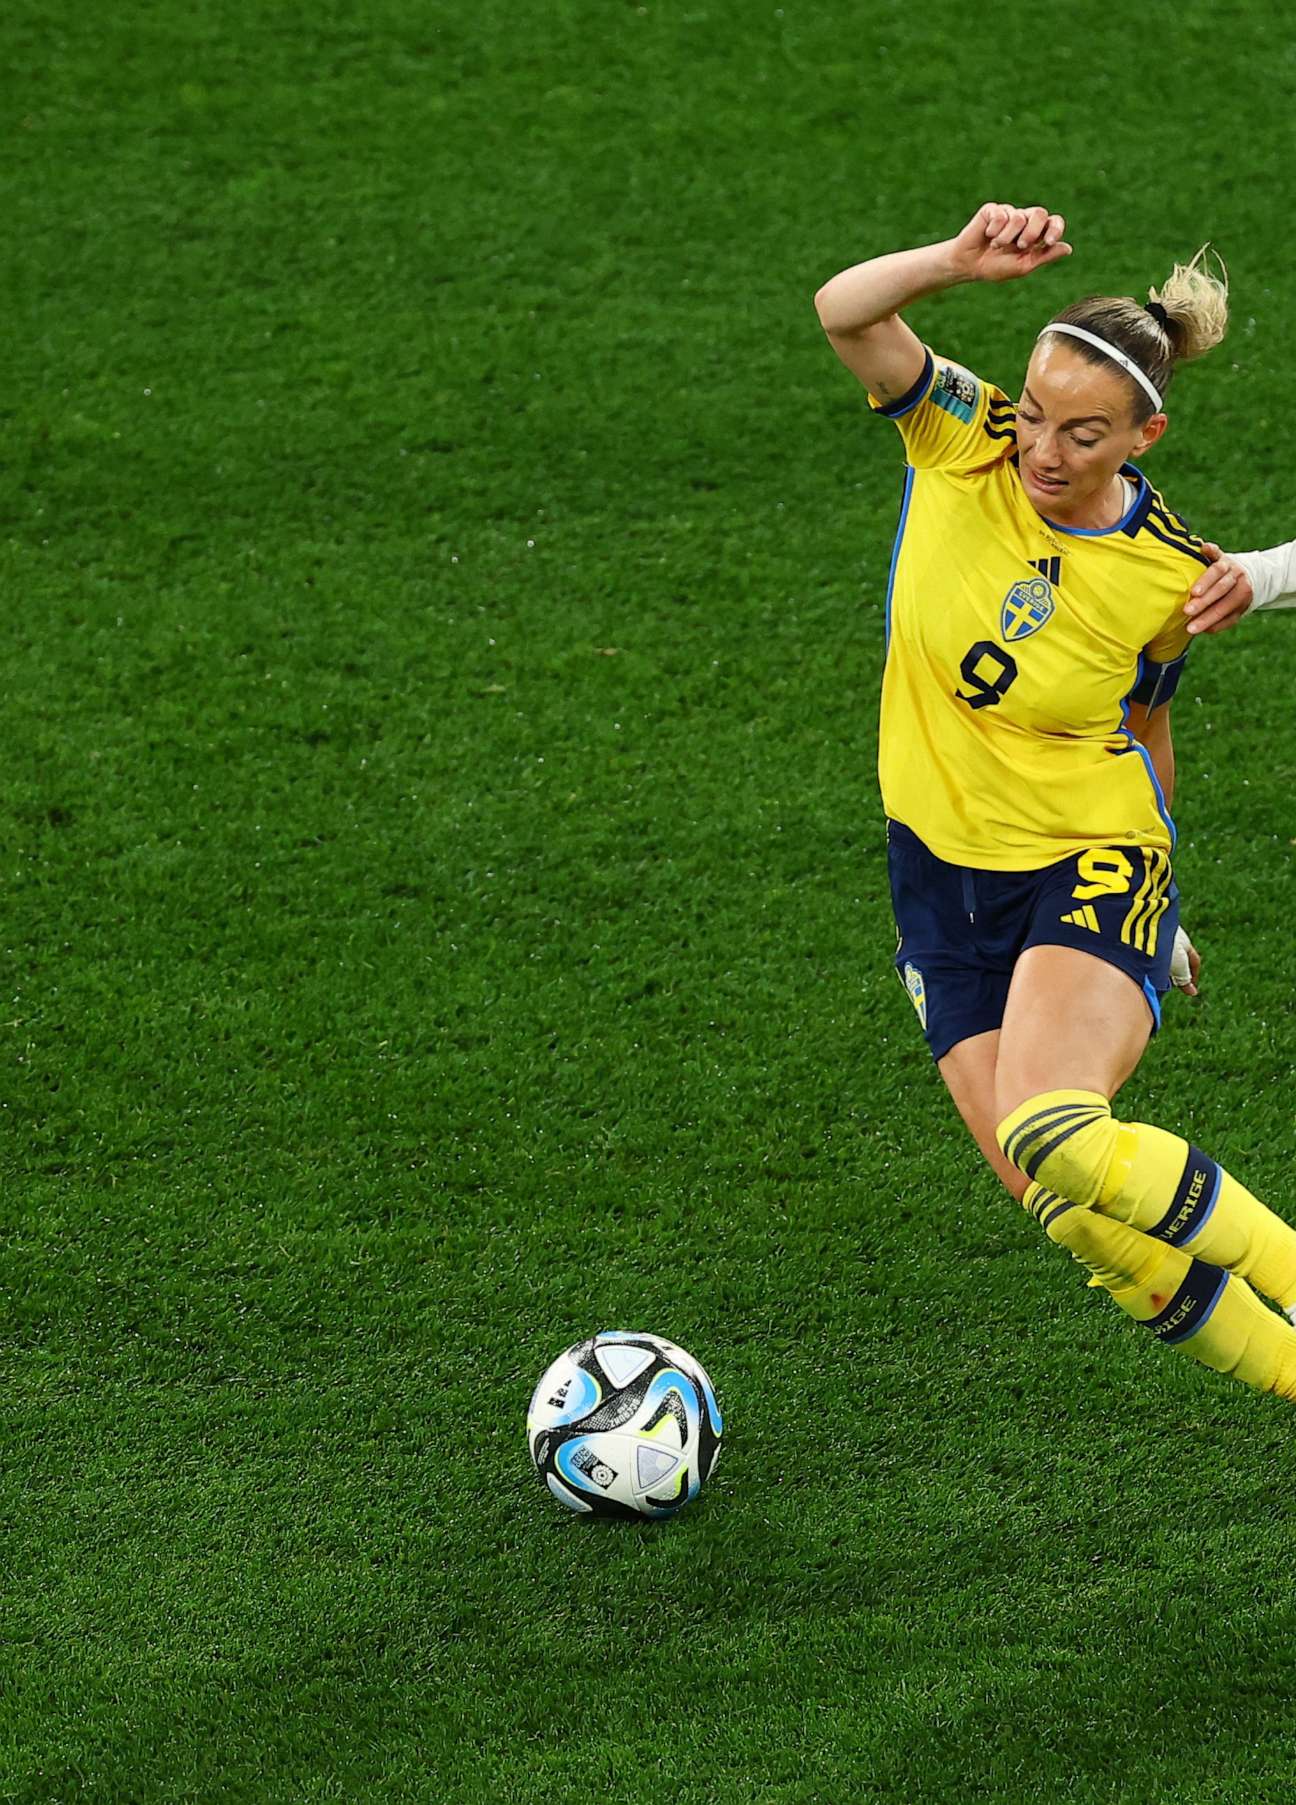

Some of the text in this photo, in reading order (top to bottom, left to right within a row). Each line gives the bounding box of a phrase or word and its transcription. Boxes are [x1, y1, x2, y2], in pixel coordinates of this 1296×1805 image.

[955, 641, 1018, 709] 9
[1071, 848, 1134, 900] 9
[1159, 1169, 1207, 1239] VERIGE
[1154, 1295, 1198, 1335] RIGE
